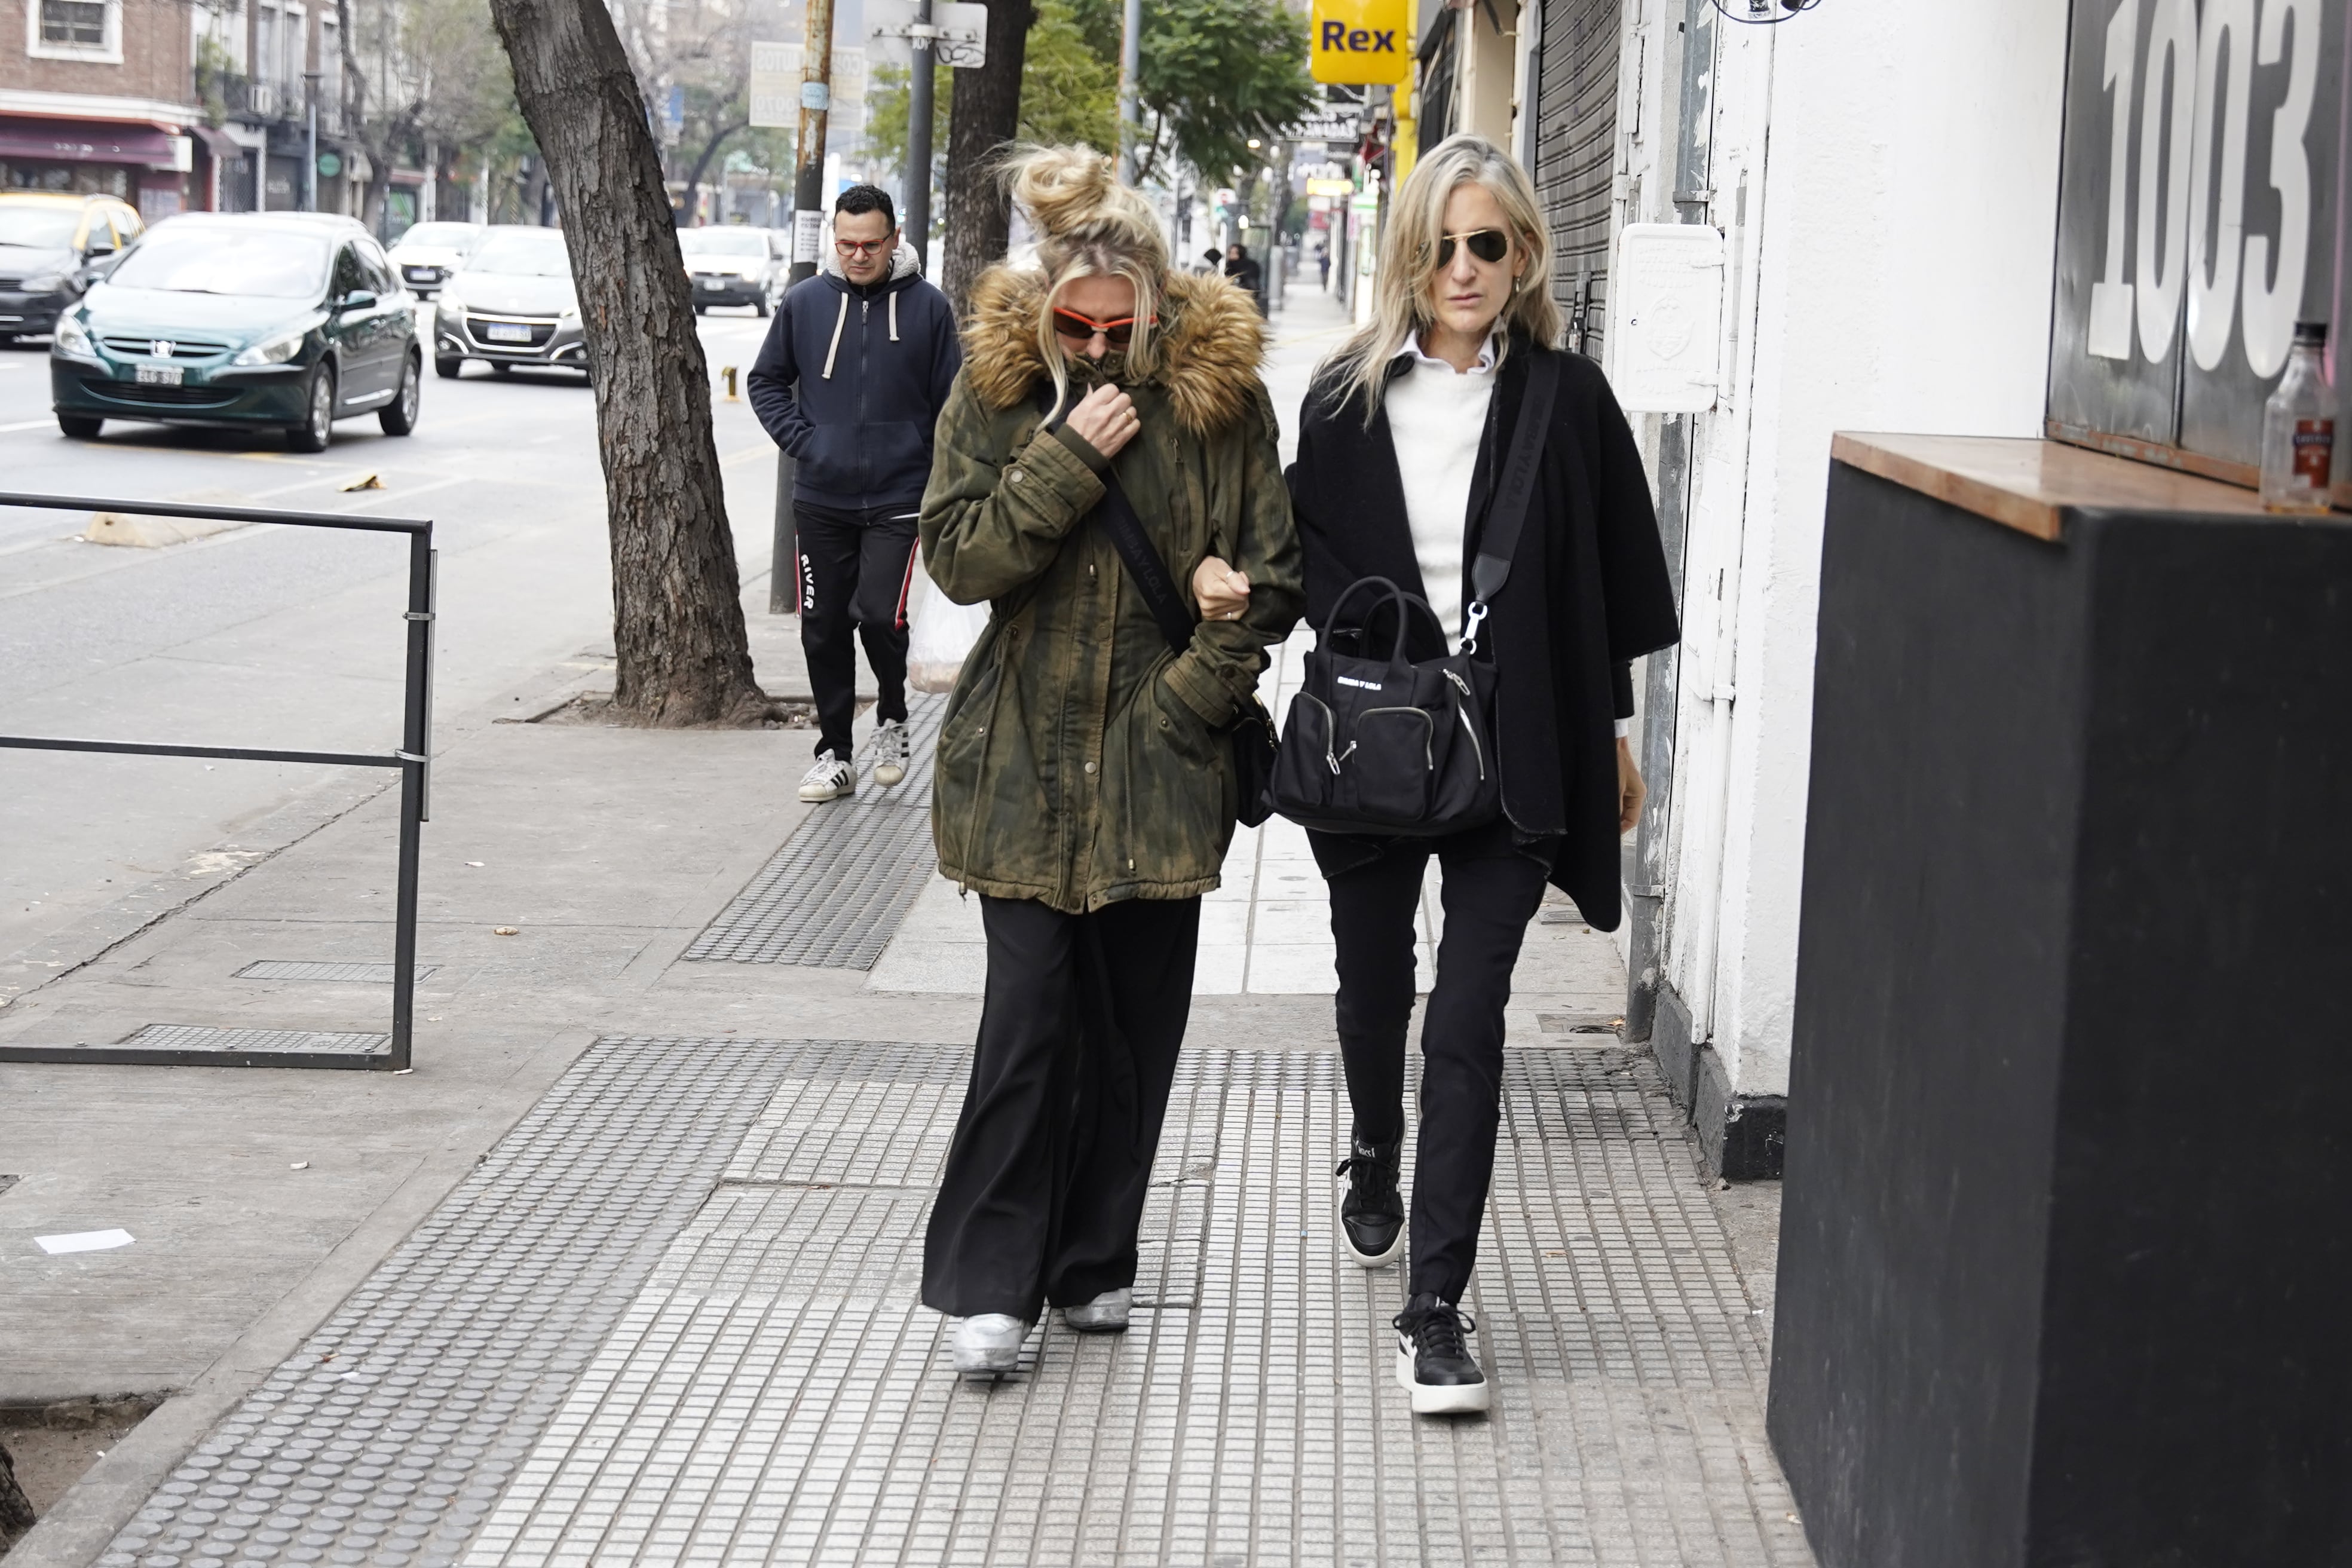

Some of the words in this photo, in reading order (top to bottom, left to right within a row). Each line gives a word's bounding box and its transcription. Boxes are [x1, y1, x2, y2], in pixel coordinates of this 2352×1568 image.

[1322, 21, 1395, 53] Rex
[2087, 0, 2323, 380] 1003
[800, 553, 815, 610] RIVER
